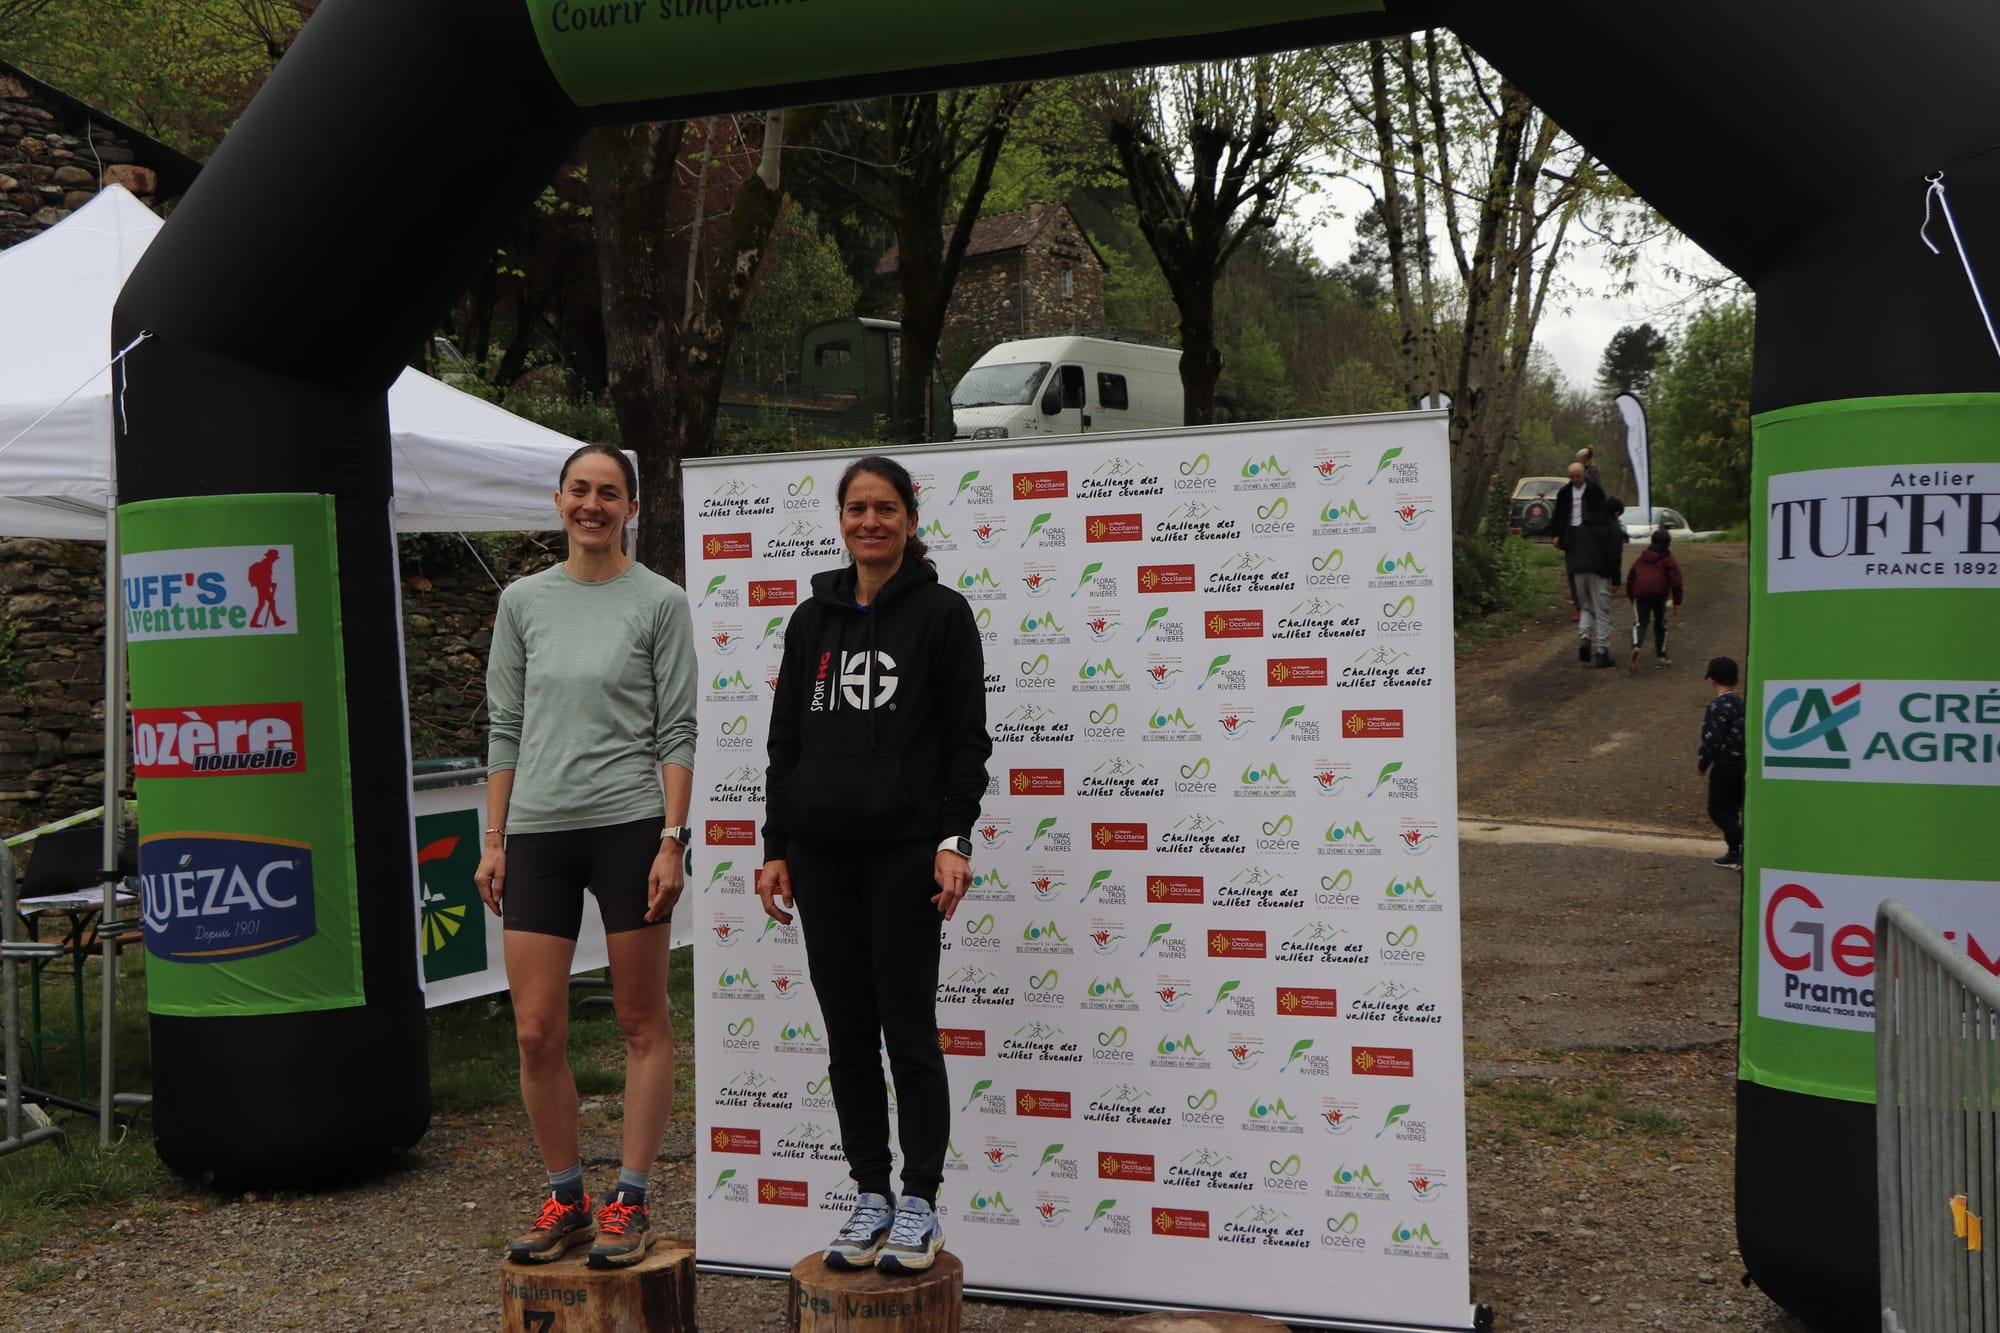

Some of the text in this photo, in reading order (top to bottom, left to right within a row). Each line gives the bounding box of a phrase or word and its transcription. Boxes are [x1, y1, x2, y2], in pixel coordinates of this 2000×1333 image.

[551, 0, 648, 32] Courir
[1392, 462, 1418, 470] FLORAC
[1081, 476, 1157, 490] Challenge des
[1174, 475, 1216, 489] lozère
[1890, 471, 1975, 487] Atelier
[1076, 487, 1112, 498] vallées
[1118, 485, 1163, 496] cévenoles
[703, 496, 769, 509] Challenge des
[783, 496, 819, 509] lozère
[699, 505, 774, 517] vallées cévenoles
[768, 537, 835, 550] Challenge des
[763, 546, 840, 557] vallées cévenoles
[1866, 562, 1998, 575] FRANCE 1892
[1209, 571, 1288, 584] Challenge des
[1204, 581, 1295, 592] vallées cévenoles
[1377, 618, 1422, 631] lozère
[1343, 666, 1425, 679] Challenge des
[1015, 676, 1055, 687] lozère
[1337, 677, 1432, 687] vallées cévenoles
[994, 723, 1045, 734] Challenge
[1084, 725, 1125, 737] lozère
[716, 736, 753, 747] lozère
[989, 733, 1074, 742] vallées cévenoles
[1863, 731, 2000, 763] AGRI
[193, 748, 297, 772] nouvelle
[1082, 777, 1158, 788] Challenge des
[1175, 780, 1217, 792] lozère
[1077, 787, 1164, 796] vallées cévenoles
[1162, 833, 1239, 845] Challenge des
[1156, 843, 1246, 853] vallées cévenoles
[141, 854, 297, 933] QUÉZAC
[195, 920, 260, 944] Depuis 1901
[961, 935, 1000, 947] lozère
[1380, 947, 1425, 960] lozère
[1024, 990, 1064, 1003] lozère
[1352, 1000, 1435, 1013] Challenge des
[1805, 1004, 1831, 1015] FLORAC
[1834, 1008, 1855, 1017] TROIS
[1346, 1010, 1441, 1022] vallées cévenoles
[723, 1037, 759, 1049] lozère
[1002, 1040, 1077, 1053] Challenge des
[997, 1049, 1083, 1062] vallées cévenoles
[1092, 1047, 1134, 1060] lozère
[720, 1087, 787, 1100] Challenge des
[715, 1096, 793, 1108] vallées cévenoles
[1089, 1102, 1165, 1115] Challenge des
[1084, 1111, 1171, 1125] vallées cévenoles
[1407, 1127, 1426, 1135] TROIS
[1169, 1166, 1247, 1180] Challenge des
[1163, 1175, 1253, 1190] vallées cévenoles
[1264, 1175, 1308, 1190] lozère
[1224, 1223, 1303, 1237] Challenge des
[1218, 1232, 1310, 1247] vallées cévenoles
[1321, 1233, 1365, 1247] lozère
[505, 1278, 587, 1307] Challenge
[800, 1288, 831, 1313] Des
